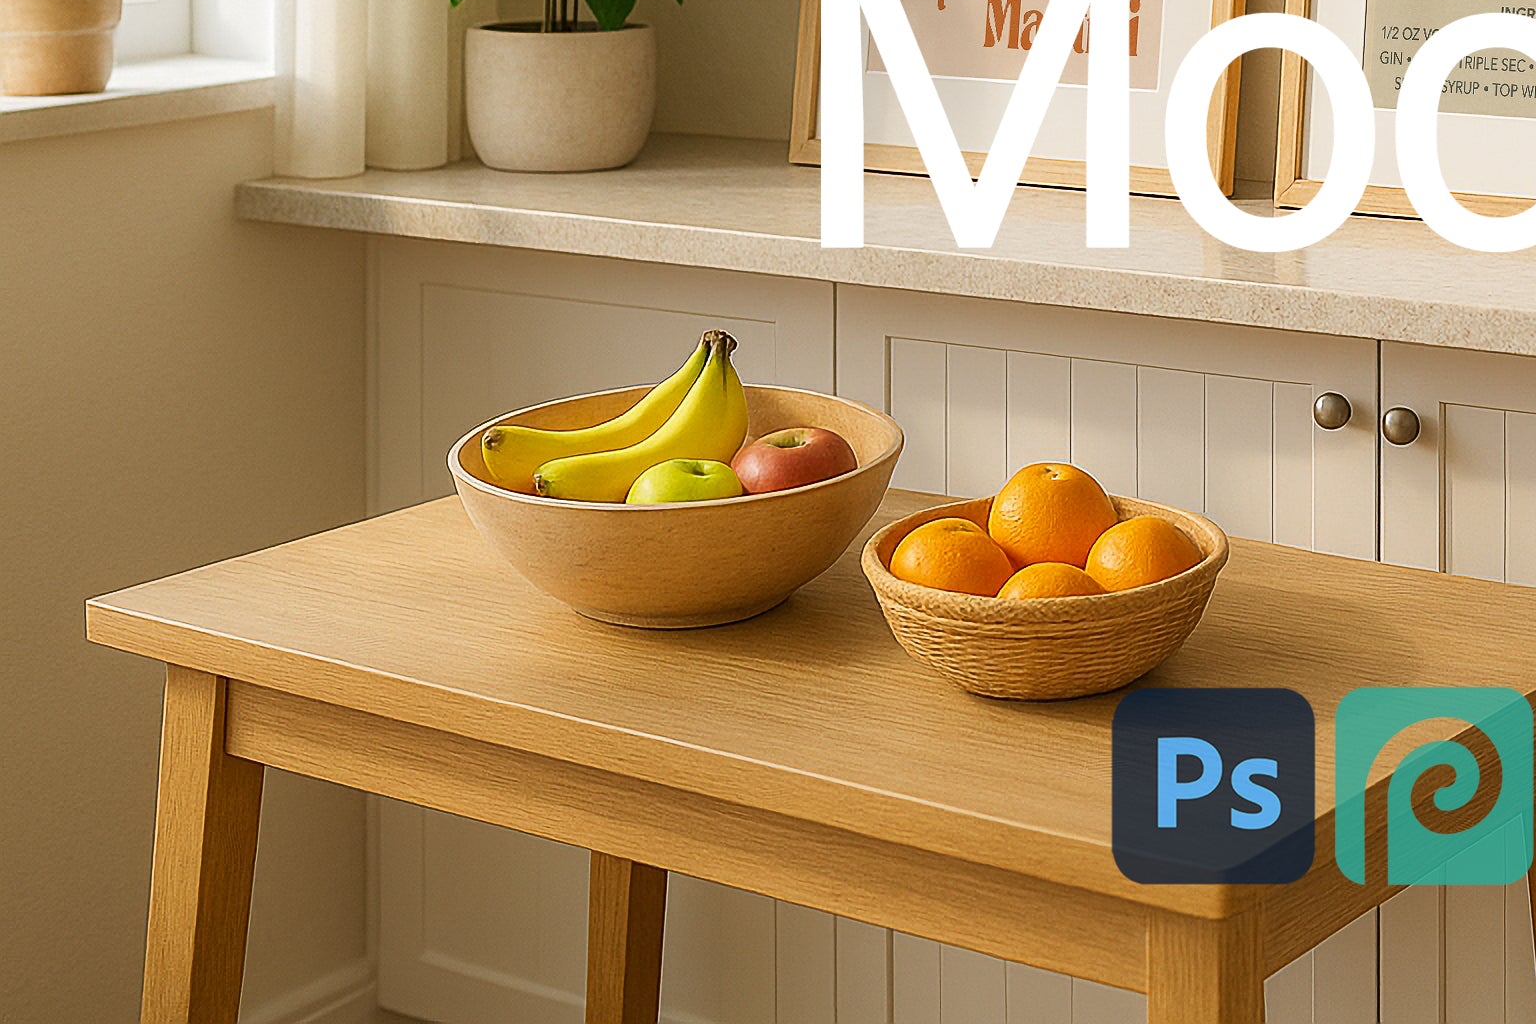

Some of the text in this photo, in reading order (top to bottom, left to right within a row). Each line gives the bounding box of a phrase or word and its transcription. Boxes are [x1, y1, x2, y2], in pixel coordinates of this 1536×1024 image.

[1381, 25, 1399, 40] 1/2
[1402, 26, 1421, 41] OZ
[1379, 50, 1404, 66] GIN
[1501, 57, 1527, 73] SEC
[1492, 82, 1519, 98] TOP
